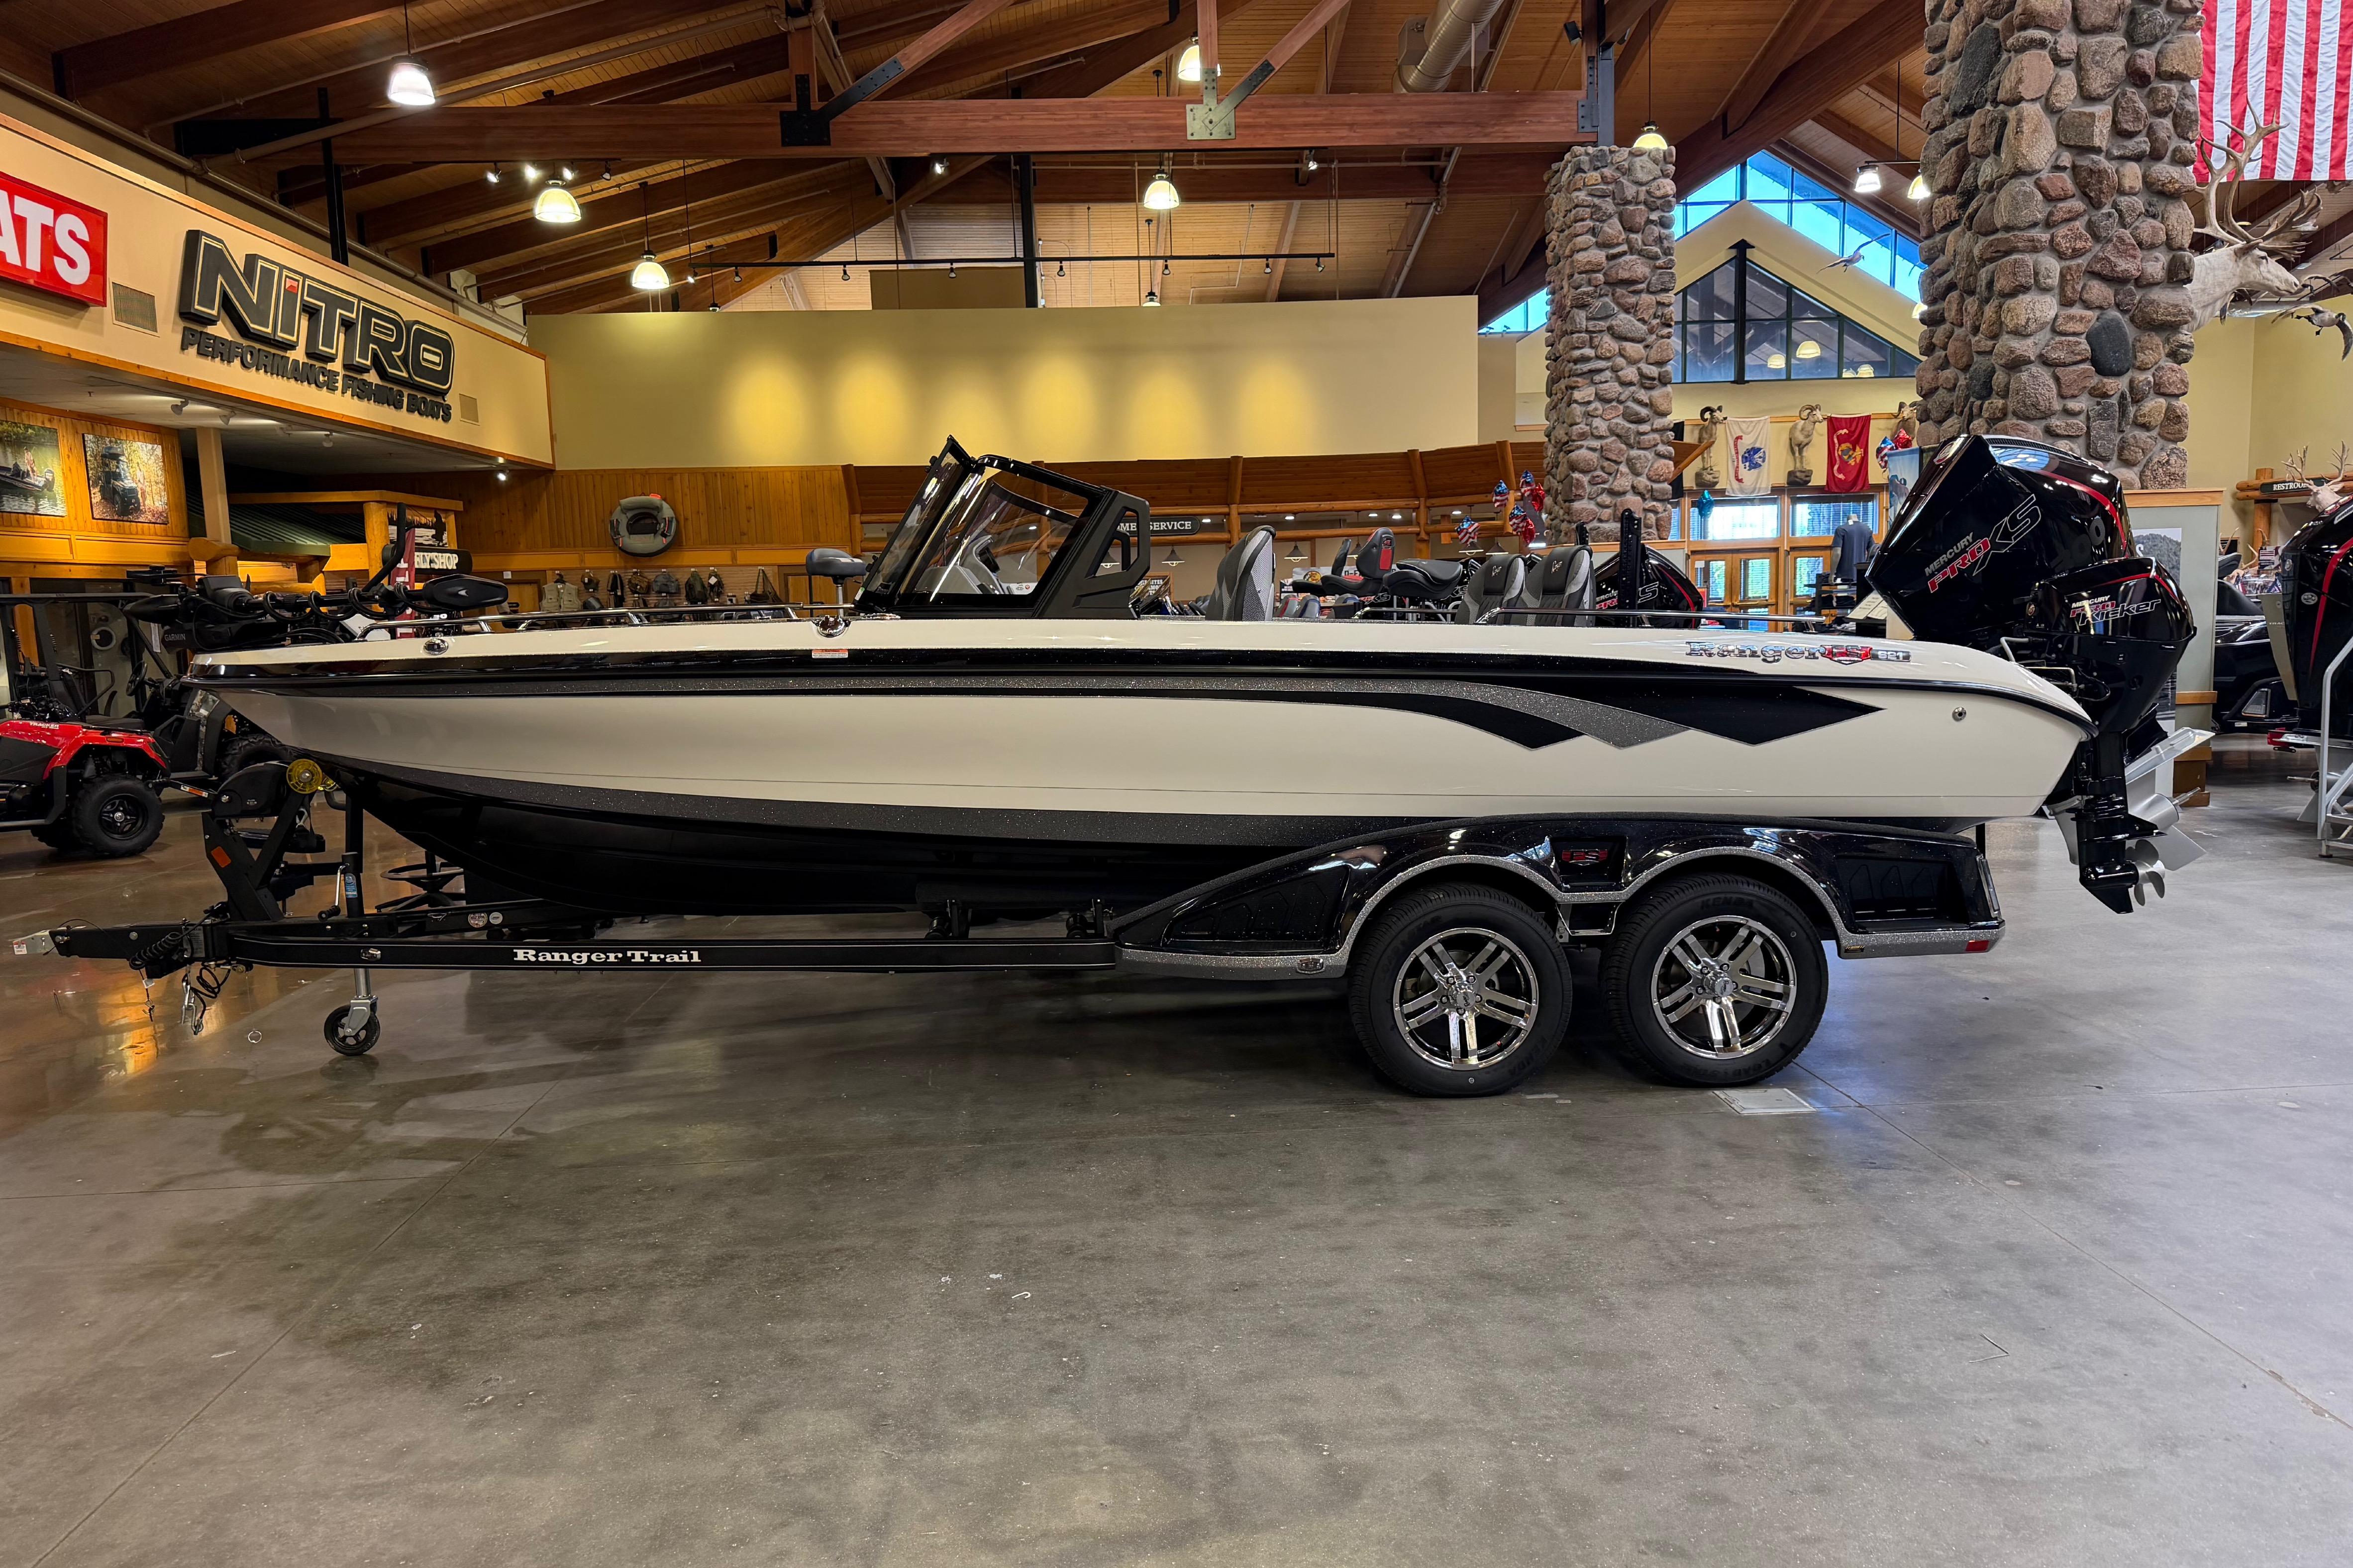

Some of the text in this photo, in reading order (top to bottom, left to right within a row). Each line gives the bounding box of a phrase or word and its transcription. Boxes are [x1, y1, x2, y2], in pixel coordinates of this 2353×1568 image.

[181, 326, 452, 422] PERFORMANCE FISHING BOATS
[1150, 521, 1192, 530] SERVICE
[1928, 493, 2041, 593] PRO XS
[431, 553, 459, 569] SHOP
[1925, 532, 1973, 577] MERCURY
[2070, 600, 2116, 617] PRO
[2071, 595, 2111, 608] MERCURY
[1685, 641, 1826, 664] Ranger
[1877, 650, 1904, 660] 621
[513, 949, 701, 965] Ranger Trail
